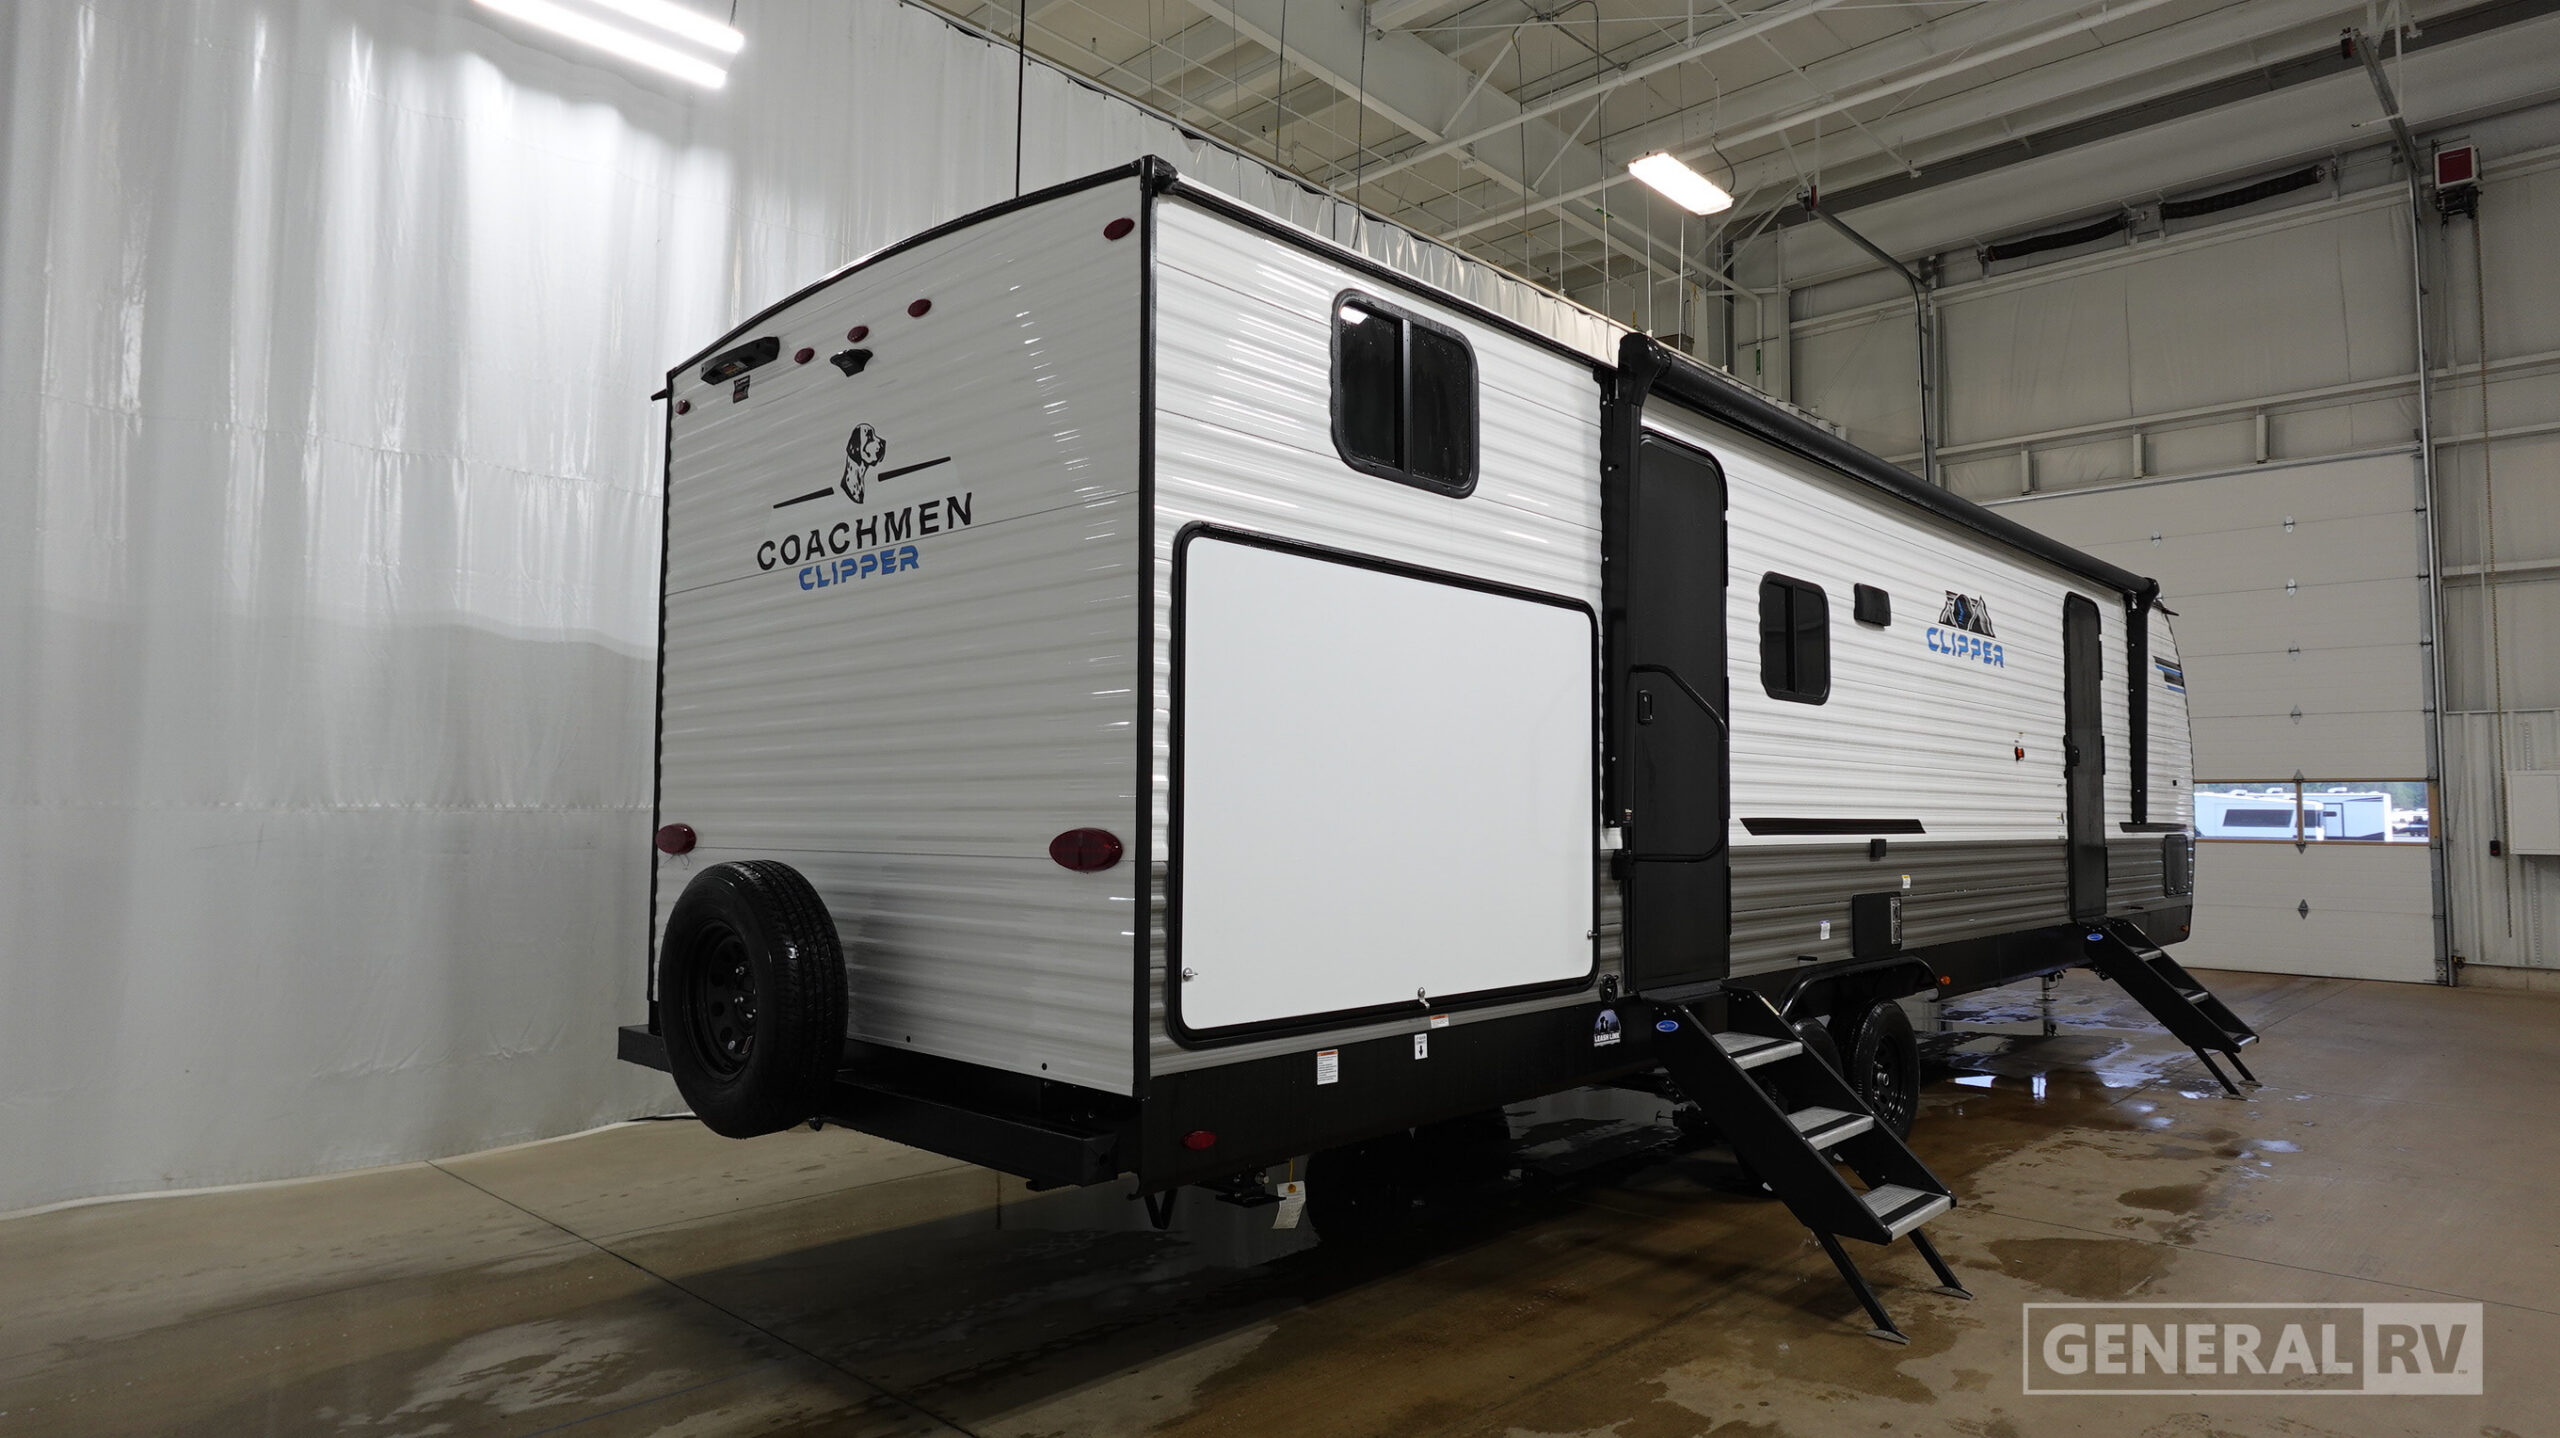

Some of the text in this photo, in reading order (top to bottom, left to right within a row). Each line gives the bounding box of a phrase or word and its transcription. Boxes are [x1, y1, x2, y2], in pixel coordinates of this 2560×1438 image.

[756, 491, 973, 571] COACHMEN
[798, 545, 919, 591] CLIPPER
[1927, 627, 2004, 668] CLIPPER
